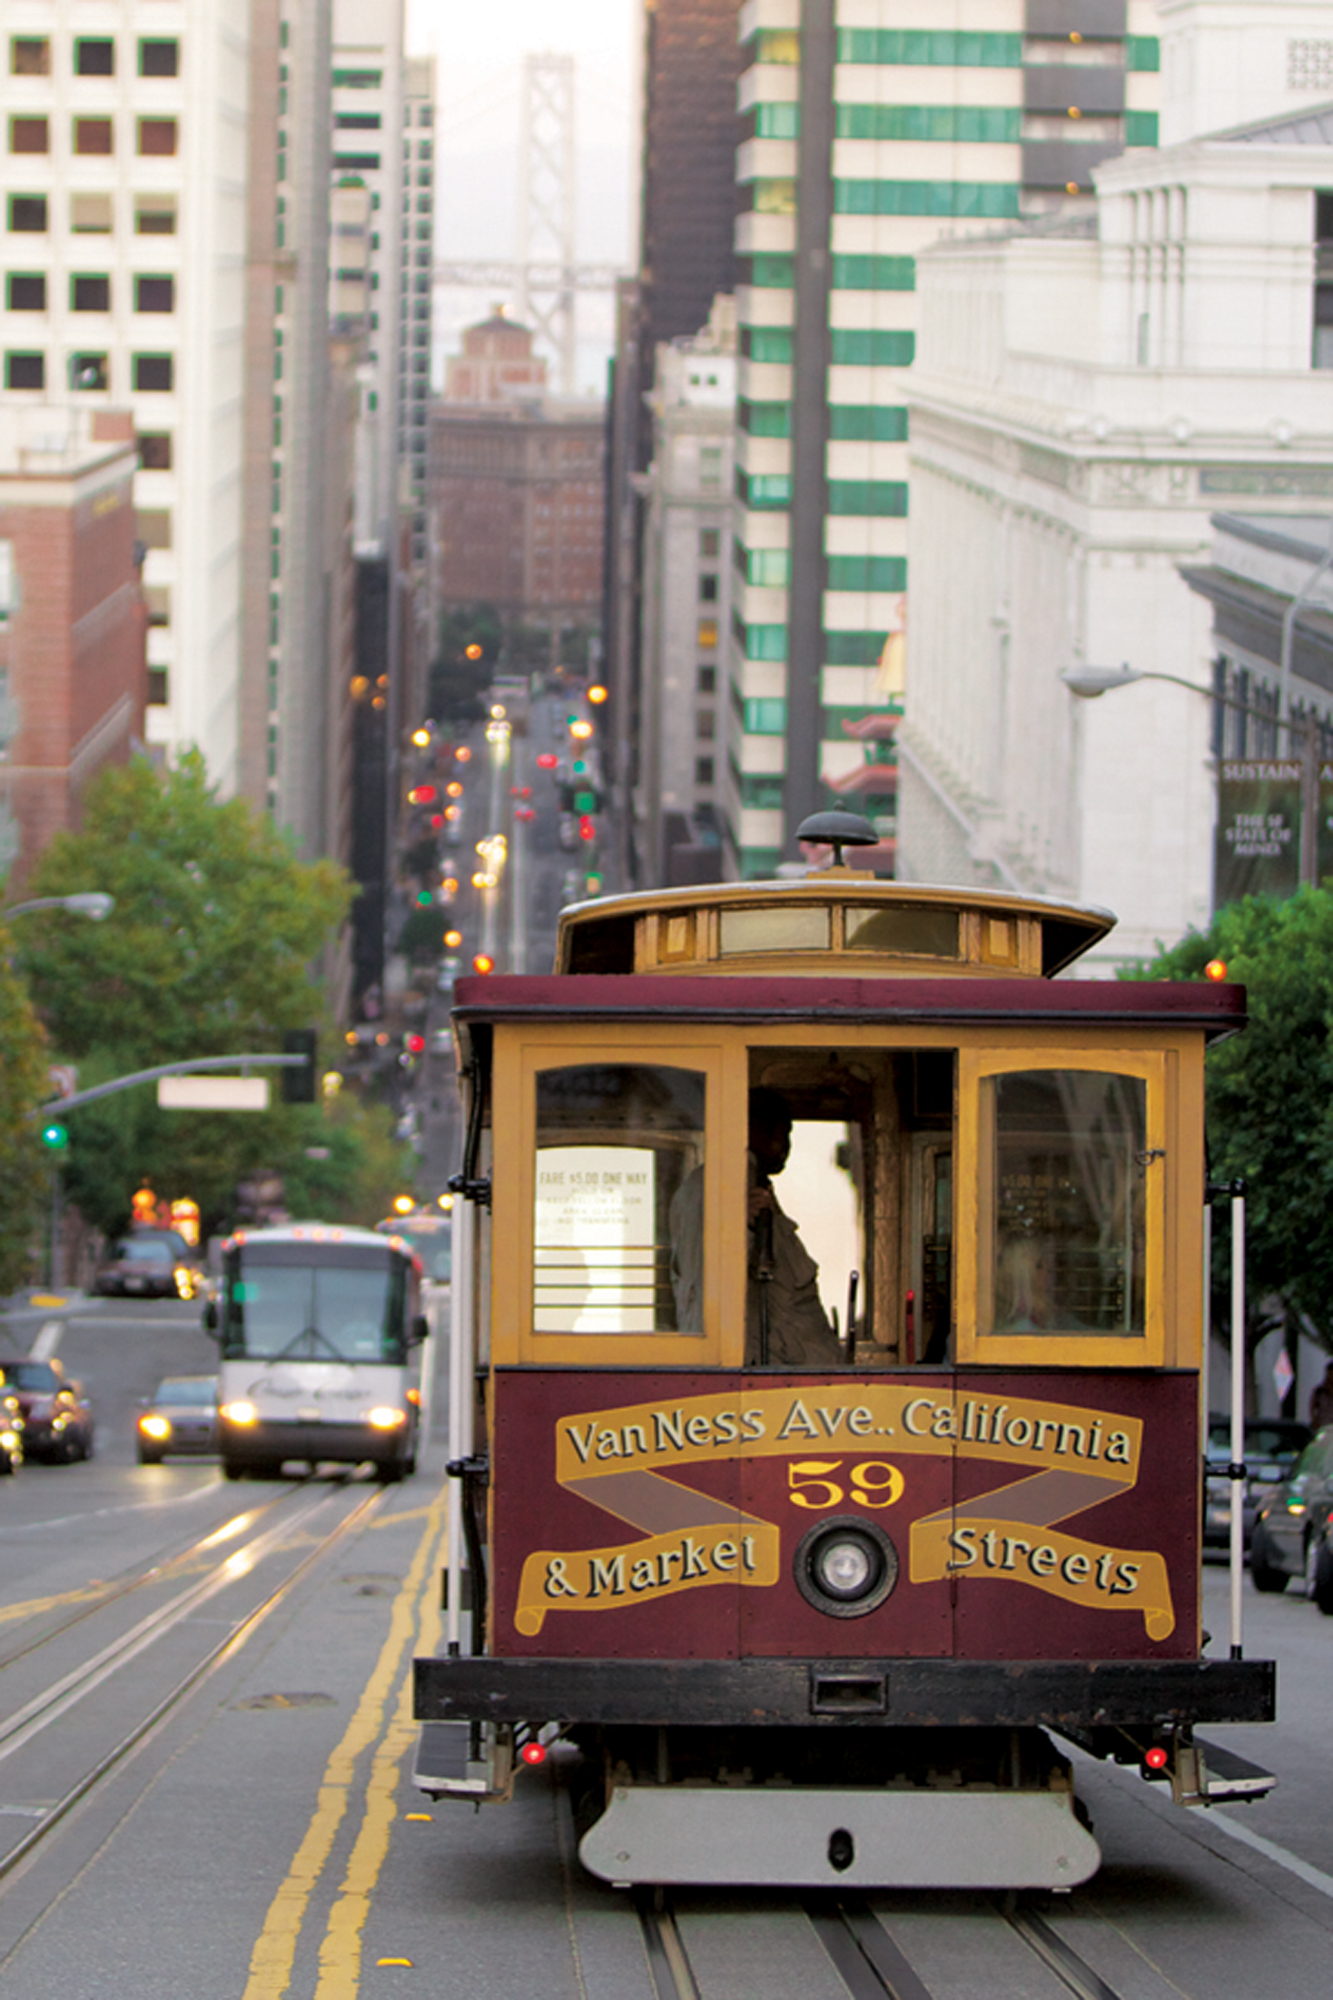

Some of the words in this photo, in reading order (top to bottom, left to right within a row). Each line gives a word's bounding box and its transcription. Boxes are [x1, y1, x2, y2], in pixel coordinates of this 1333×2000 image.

[1223, 763, 1299, 780] SUSTAIN
[1235, 814, 1264, 828] THE
[540, 1172, 564, 1185] FARE
[602, 1172, 622, 1185] ONE
[626, 1172, 647, 1185] WAY
[565, 1422, 648, 1463] Van
[650, 1408, 767, 1451] Ness
[902, 1397, 1132, 1464] California
[788, 1459, 905, 1510] 59
[544, 1557, 579, 1598] &
[585, 1535, 756, 1599] Market
[946, 1527, 1143, 1596] Streets
